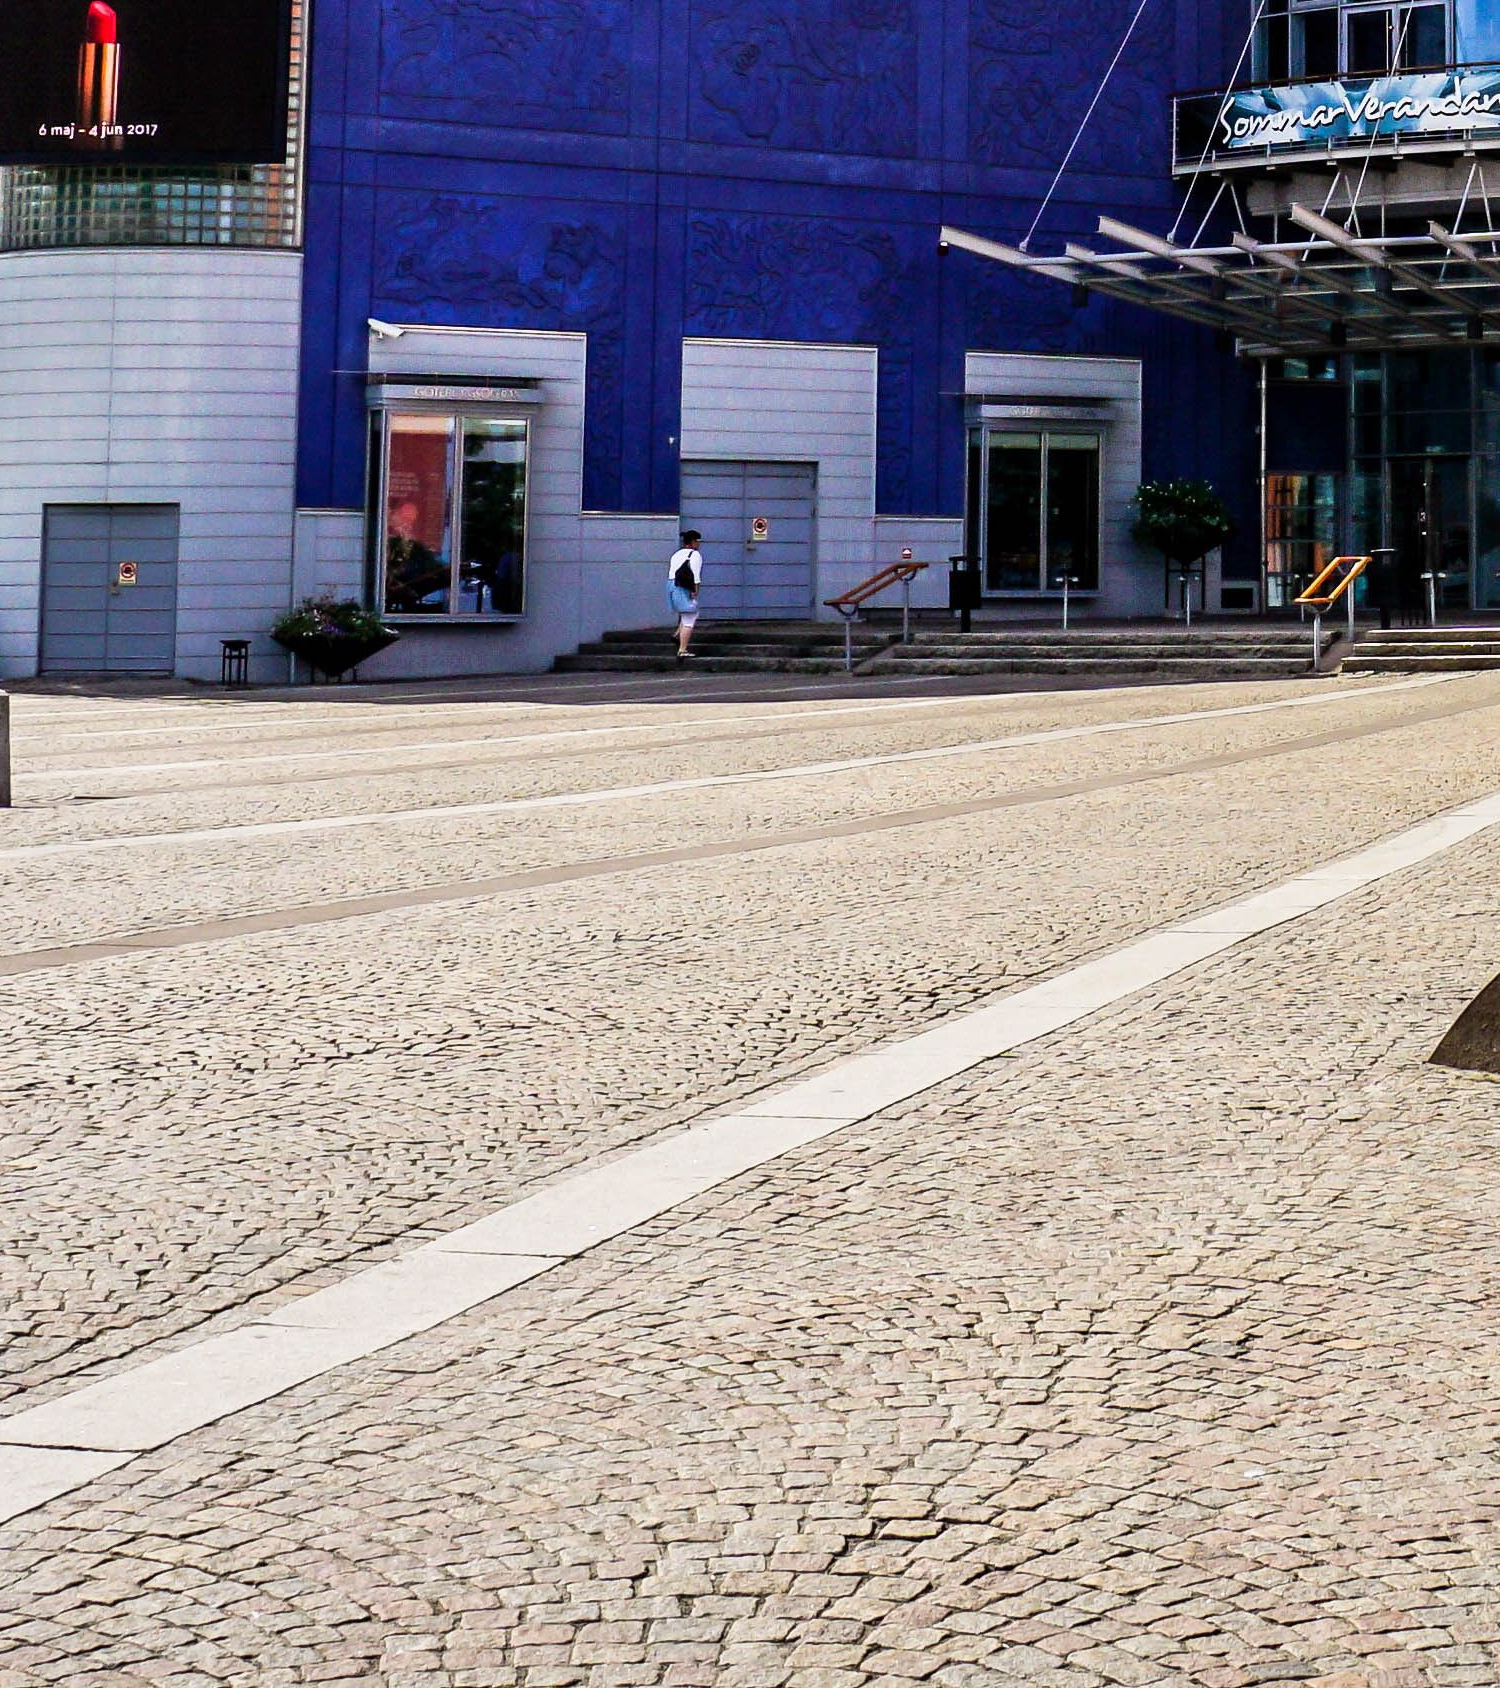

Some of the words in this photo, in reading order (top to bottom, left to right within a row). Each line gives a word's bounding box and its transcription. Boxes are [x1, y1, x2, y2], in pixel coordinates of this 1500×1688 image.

[38, 123, 47, 136] 6
[50, 122, 75, 140] maj
[88, 125, 98, 137] 4
[100, 121, 123, 139] jun
[127, 124, 158, 137] 2017
